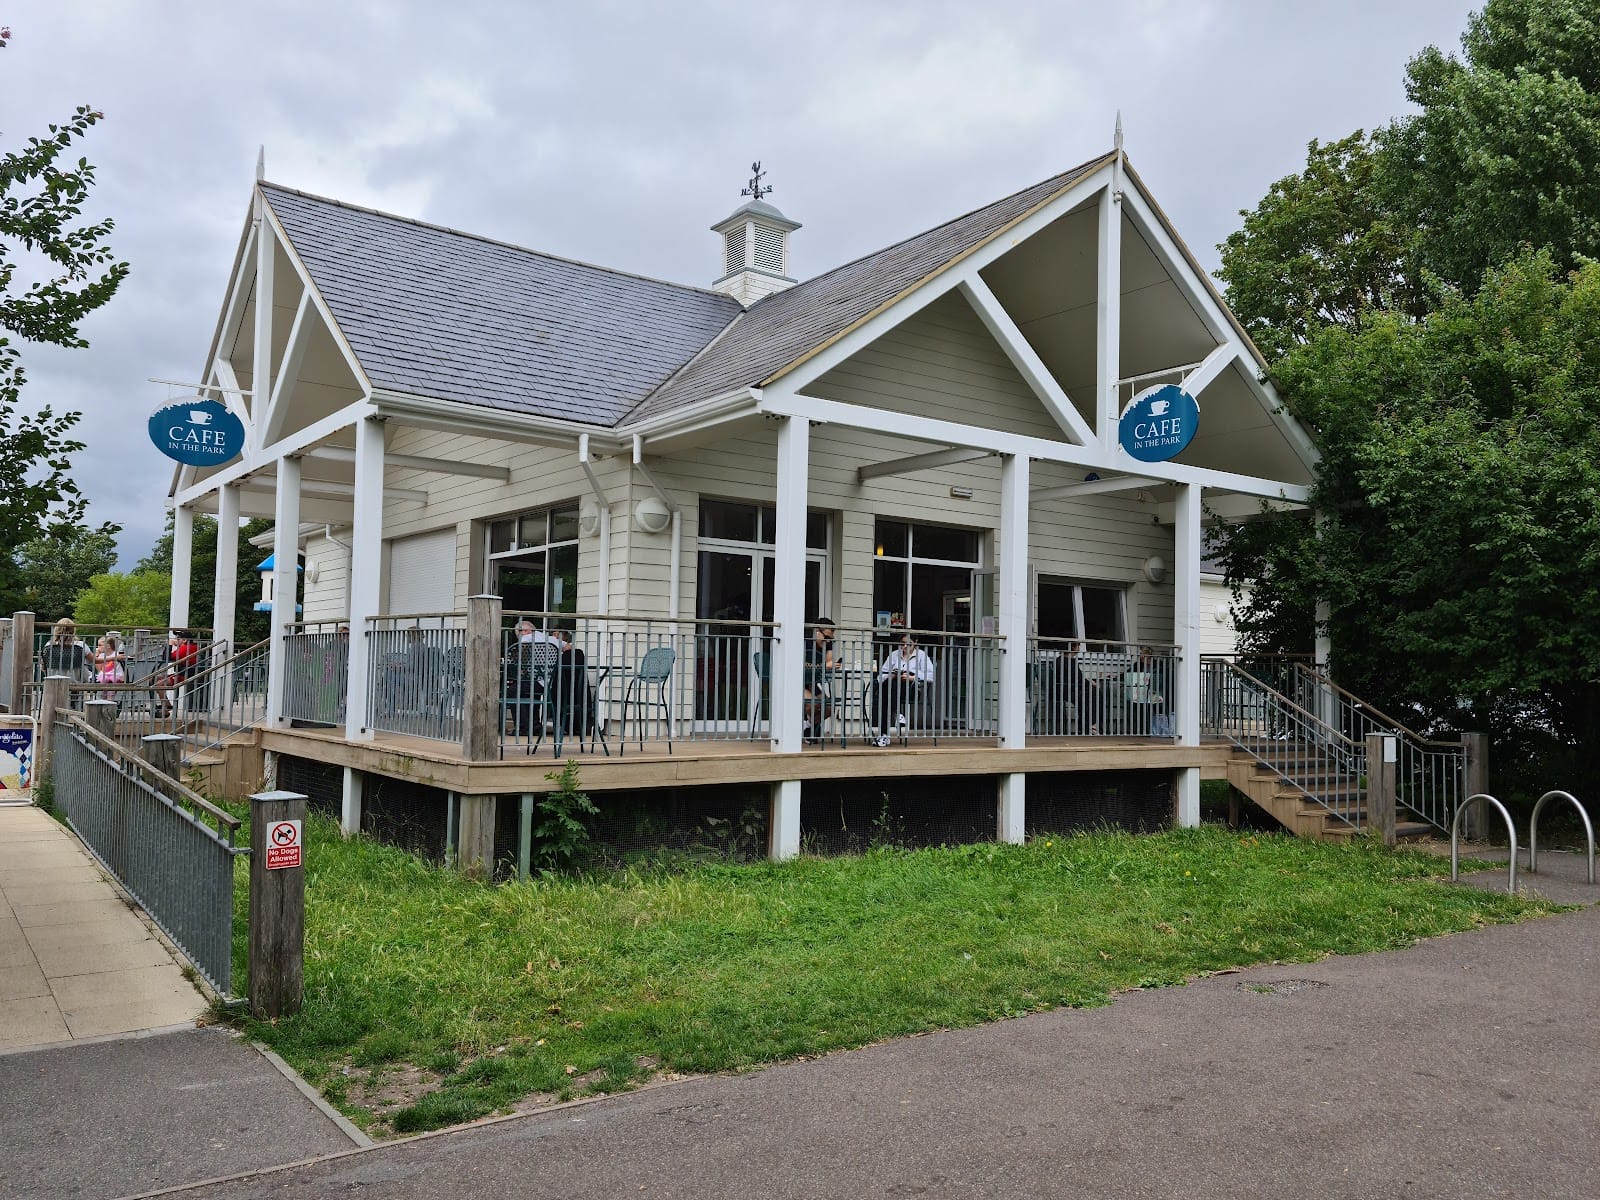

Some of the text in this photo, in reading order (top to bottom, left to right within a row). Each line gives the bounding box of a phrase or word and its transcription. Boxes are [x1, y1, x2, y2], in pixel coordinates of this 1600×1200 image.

[1134, 417, 1181, 440] CAFE
[168, 426, 226, 446] CAFE
[1134, 435, 1181, 449] IN THE PARK
[181, 443, 200, 452] THE
[202, 445, 225, 455] PARK
[270, 855, 298, 863] Allowed
